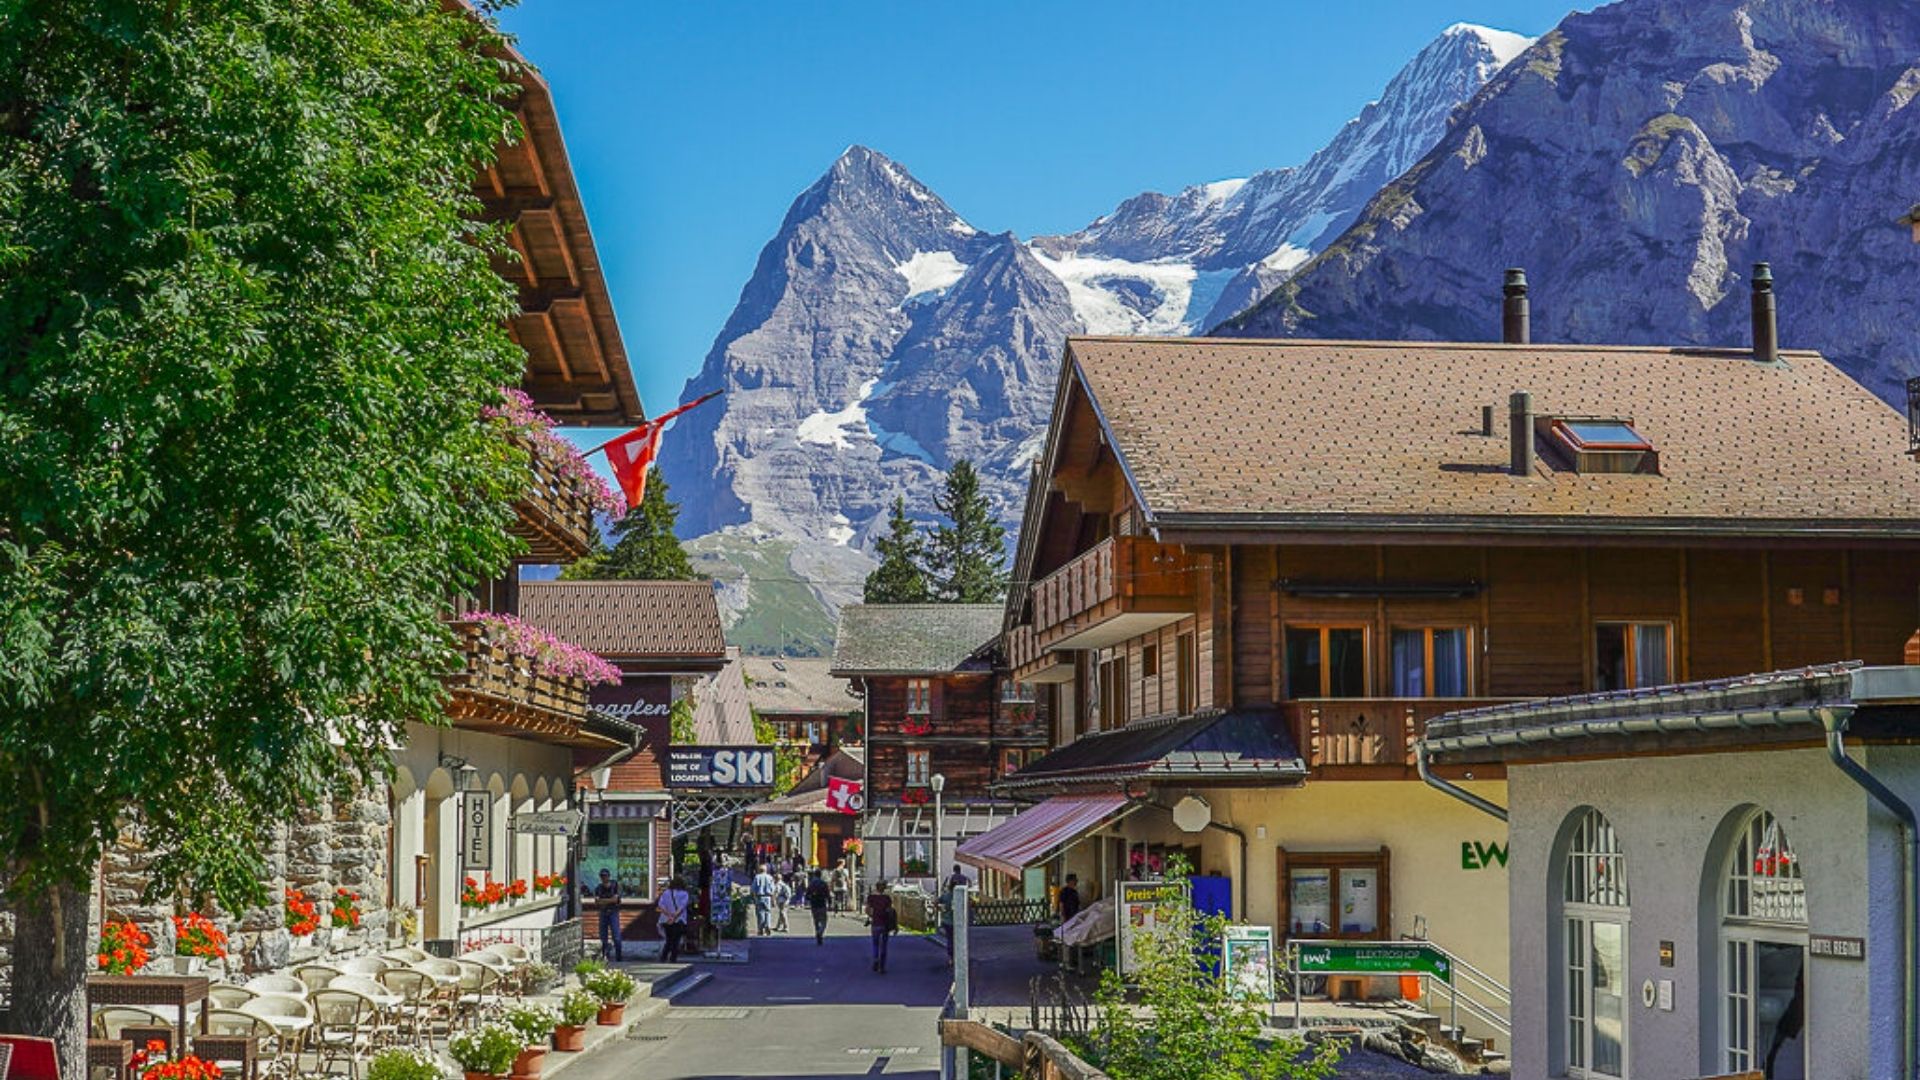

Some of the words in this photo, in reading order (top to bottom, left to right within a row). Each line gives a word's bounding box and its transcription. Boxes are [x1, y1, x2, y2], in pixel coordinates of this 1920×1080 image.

[671, 774, 711, 782] LOCATION
[712, 750, 773, 784] SKI
[471, 798, 484, 864] HOTEL
